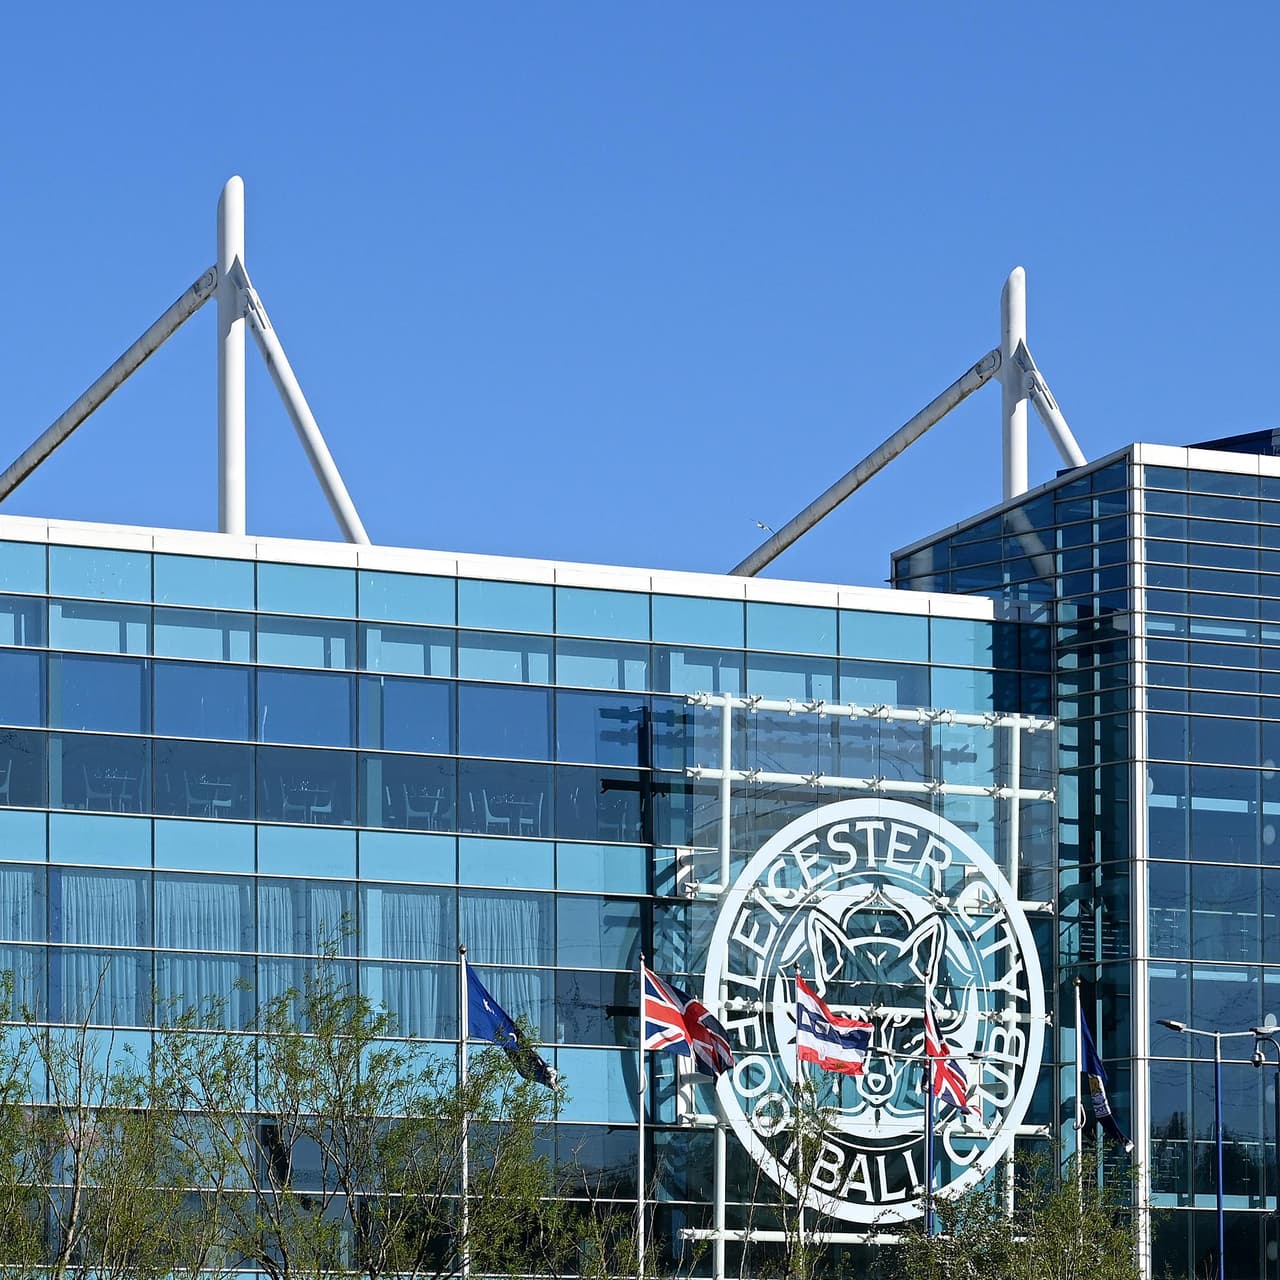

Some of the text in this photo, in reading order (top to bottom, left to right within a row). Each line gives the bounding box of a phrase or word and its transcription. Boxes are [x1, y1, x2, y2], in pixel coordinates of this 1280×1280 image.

[732, 819, 1028, 1001] LEICESTER CITY
[726, 1014, 937, 1203] FOOBALL
